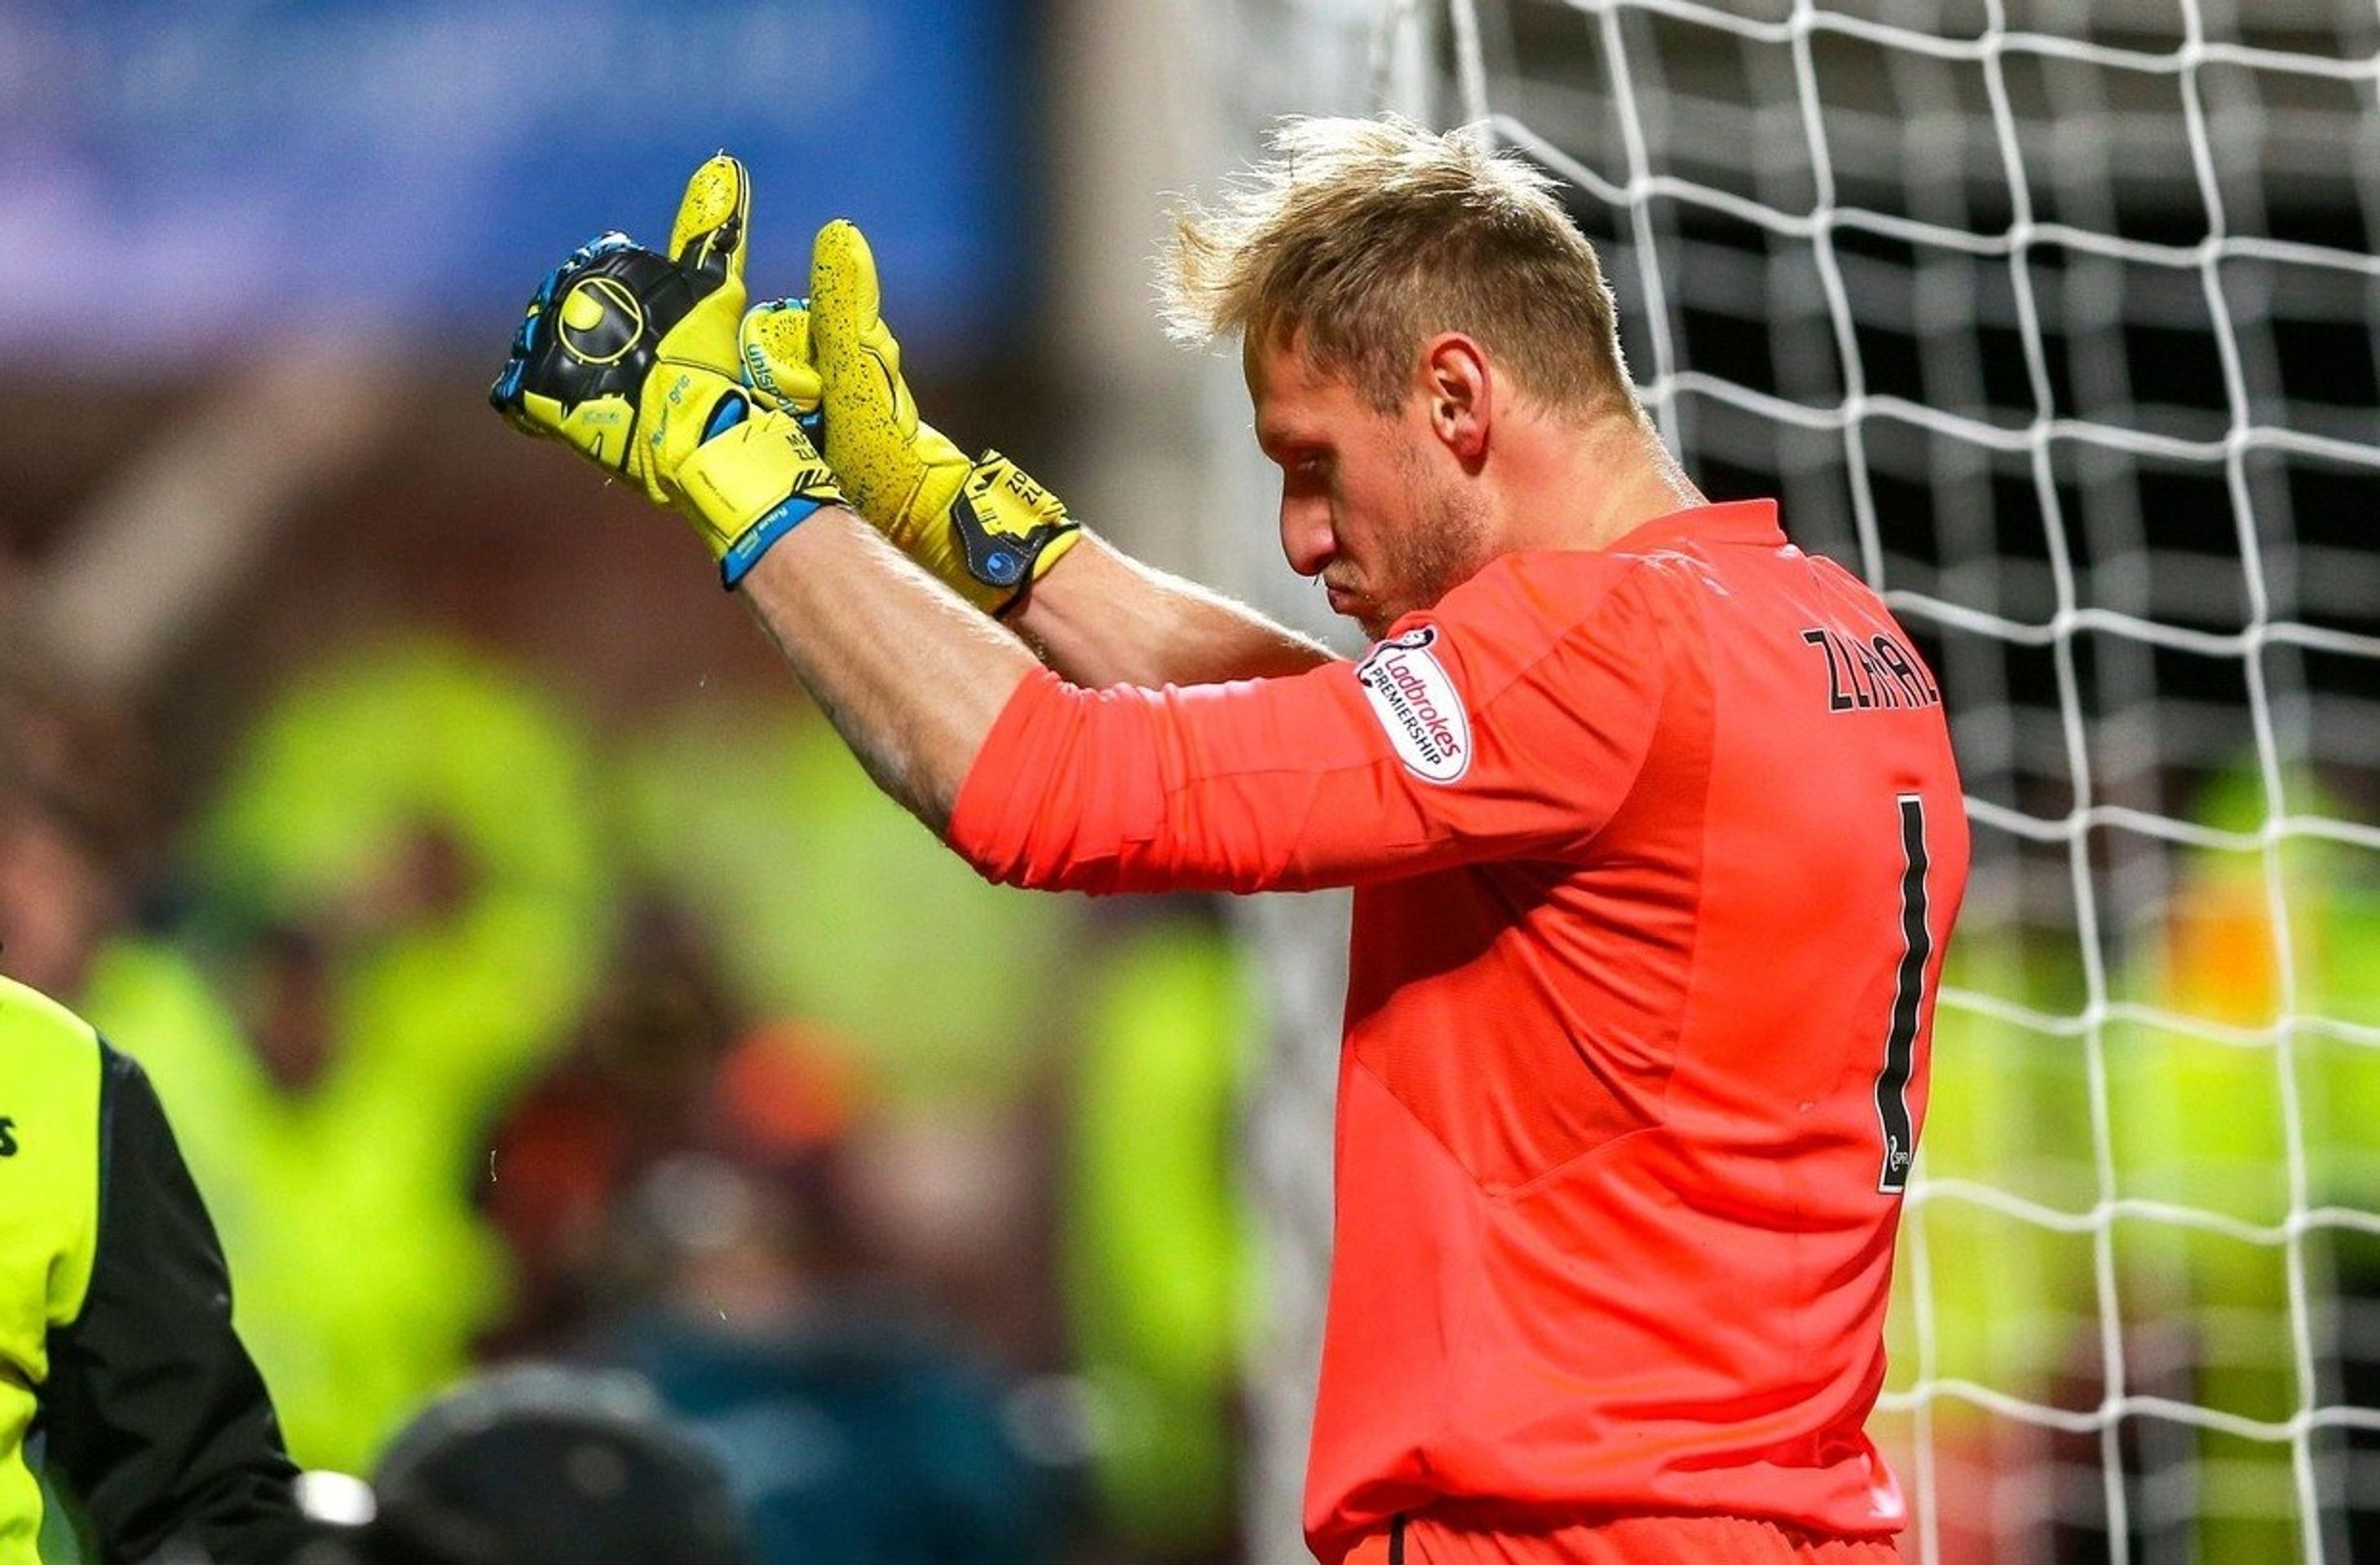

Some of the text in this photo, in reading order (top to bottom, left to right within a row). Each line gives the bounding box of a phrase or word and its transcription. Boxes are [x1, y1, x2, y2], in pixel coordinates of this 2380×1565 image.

[1370, 667, 1442, 765] PREMIERSHIP
[1385, 654, 1461, 758] Ladbrokes
[1874, 794, 1933, 1193] 1
